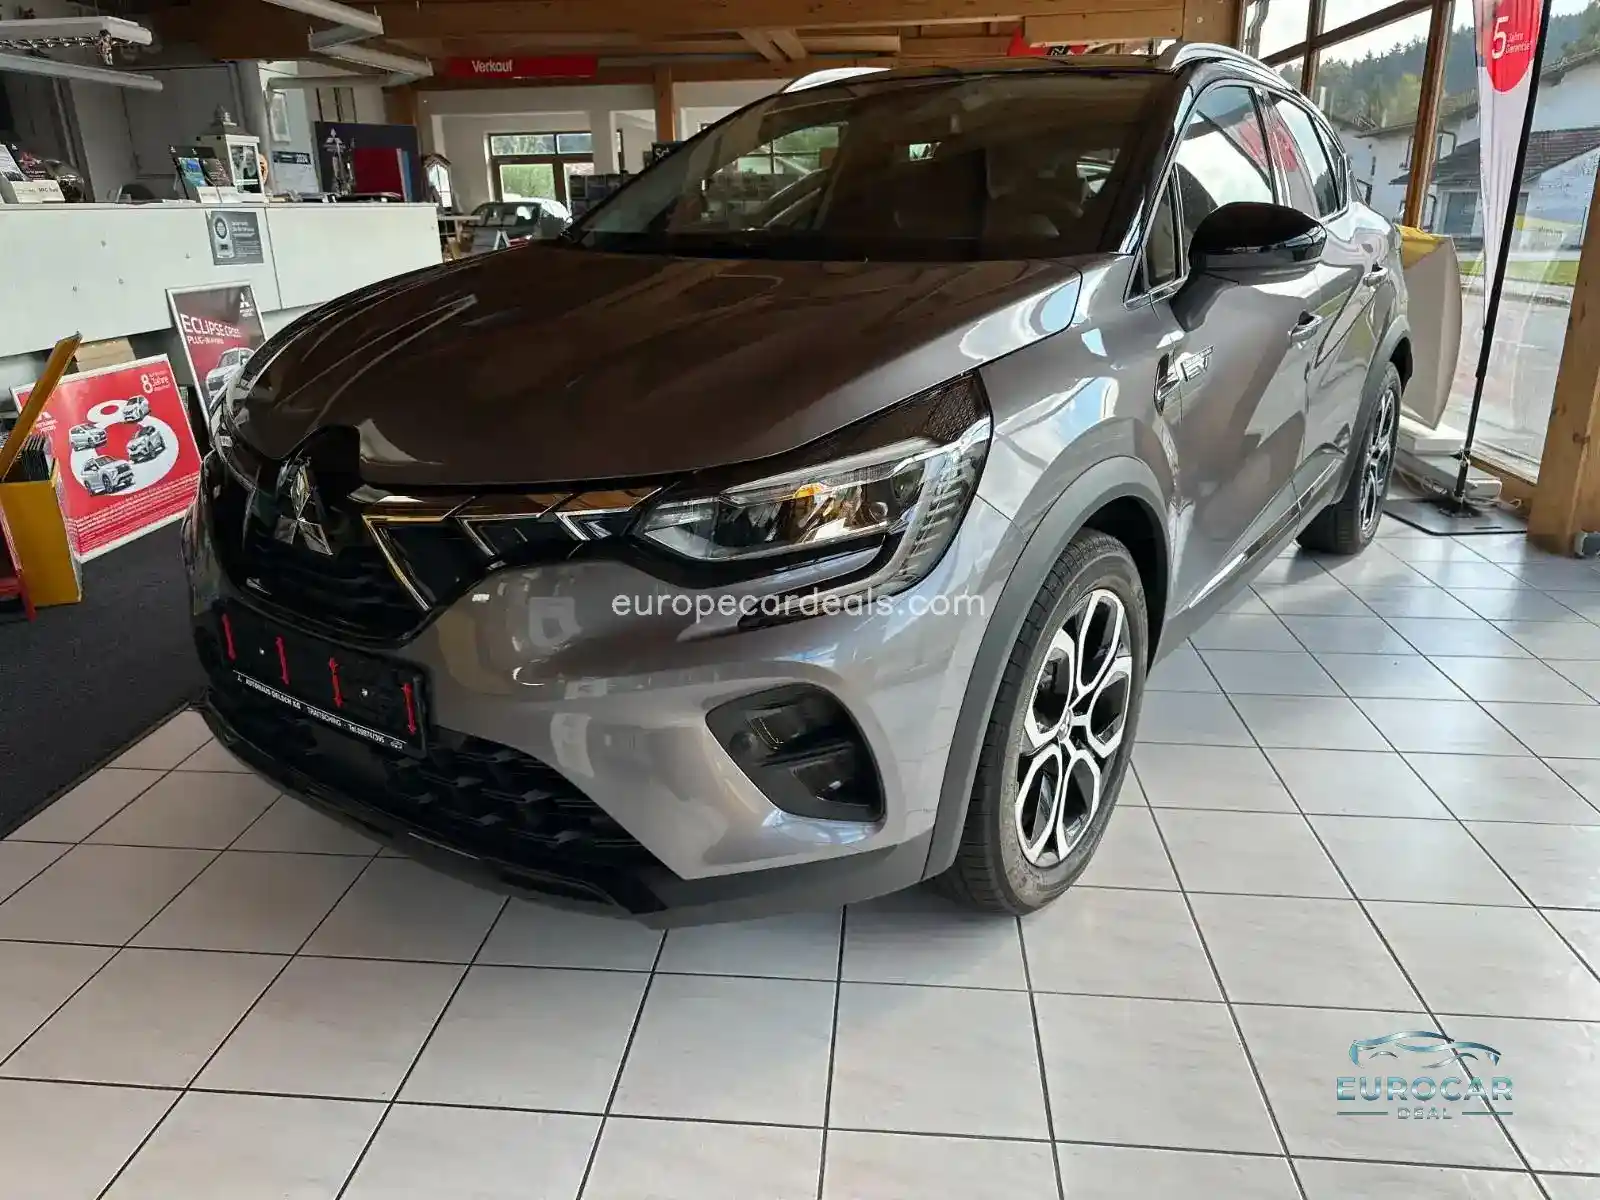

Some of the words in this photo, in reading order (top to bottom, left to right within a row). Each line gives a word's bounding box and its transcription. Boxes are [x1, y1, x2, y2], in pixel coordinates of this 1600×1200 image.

[1491, 15, 1510, 60] 5
[471, 59, 513, 73] Verkauf
[180, 313, 225, 337] ECLIPSE
[141, 373, 154, 394] 8
